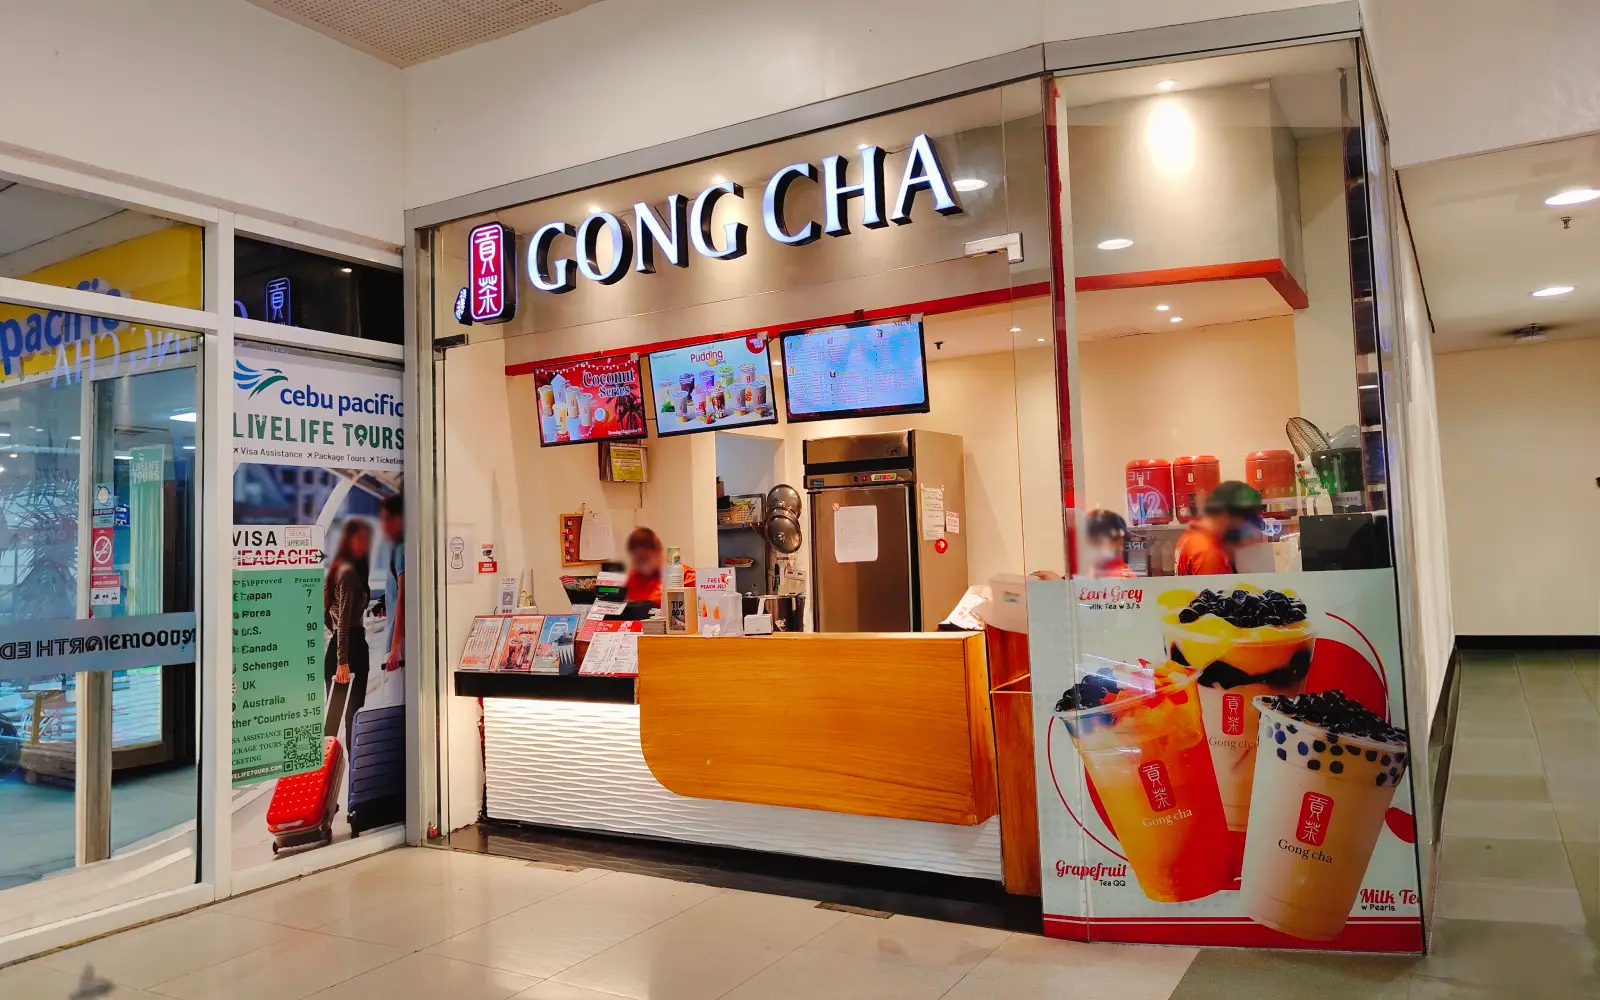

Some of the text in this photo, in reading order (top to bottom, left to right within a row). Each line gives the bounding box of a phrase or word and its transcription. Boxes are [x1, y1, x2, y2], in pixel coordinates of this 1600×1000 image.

[527, 133, 963, 294] GONG CHA
[474, 229, 499, 314] 貢茶
[690, 350, 723, 363] Pudding
[583, 368, 635, 387] Coconut
[599, 384, 631, 398] Series
[280, 384, 404, 417] cebu pacific
[233, 412, 404, 451] LIVELIFE TOURS
[240, 447, 303, 459] Visa Assistance
[314, 452, 366, 463] Package Tours
[233, 530, 277, 547] VISA
[306, 589, 312, 598] 7
[1079, 585, 1143, 603] Earl Grey
[306, 605, 312, 614] 7
[671, 600, 684, 609] TIP
[671, 609, 685, 617] BOX
[306, 622, 318, 631] 90
[306, 639, 316, 648] 15
[242, 656, 316, 672] Schengen 15
[242, 673, 316, 690] UK 15
[242, 693, 316, 709] Australia 10
[303, 706, 321, 717] 3-15
[242, 730, 283, 743] ASSISTANCE
[1209, 737, 1237, 750] Gong
[259, 740, 283, 750] TOURS
[1142, 808, 1193, 827] Gong cha
[1278, 838, 1333, 864] Gong cha
[1055, 859, 1127, 881] Grapefruit
[1099, 879, 1126, 887] Tea QQ
[1359, 888, 1396, 904] Milk
